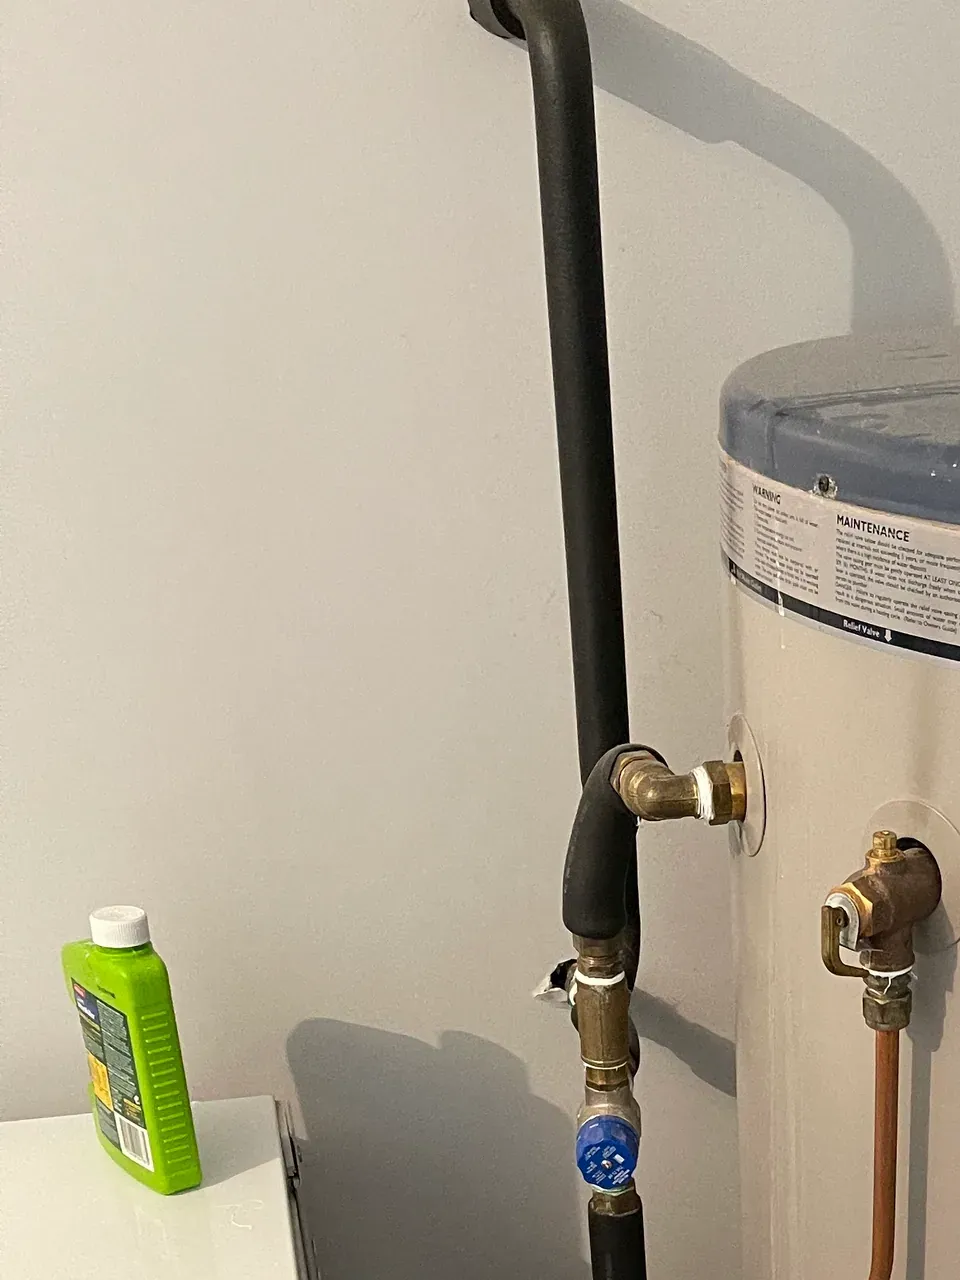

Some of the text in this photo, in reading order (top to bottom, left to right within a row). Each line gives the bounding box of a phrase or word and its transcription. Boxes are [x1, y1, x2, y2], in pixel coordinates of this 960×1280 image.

[836, 514, 910, 542] MAINTENANCE
[932, 576, 947, 584] LEAST
[843, 619, 880, 637] Relief Valve
